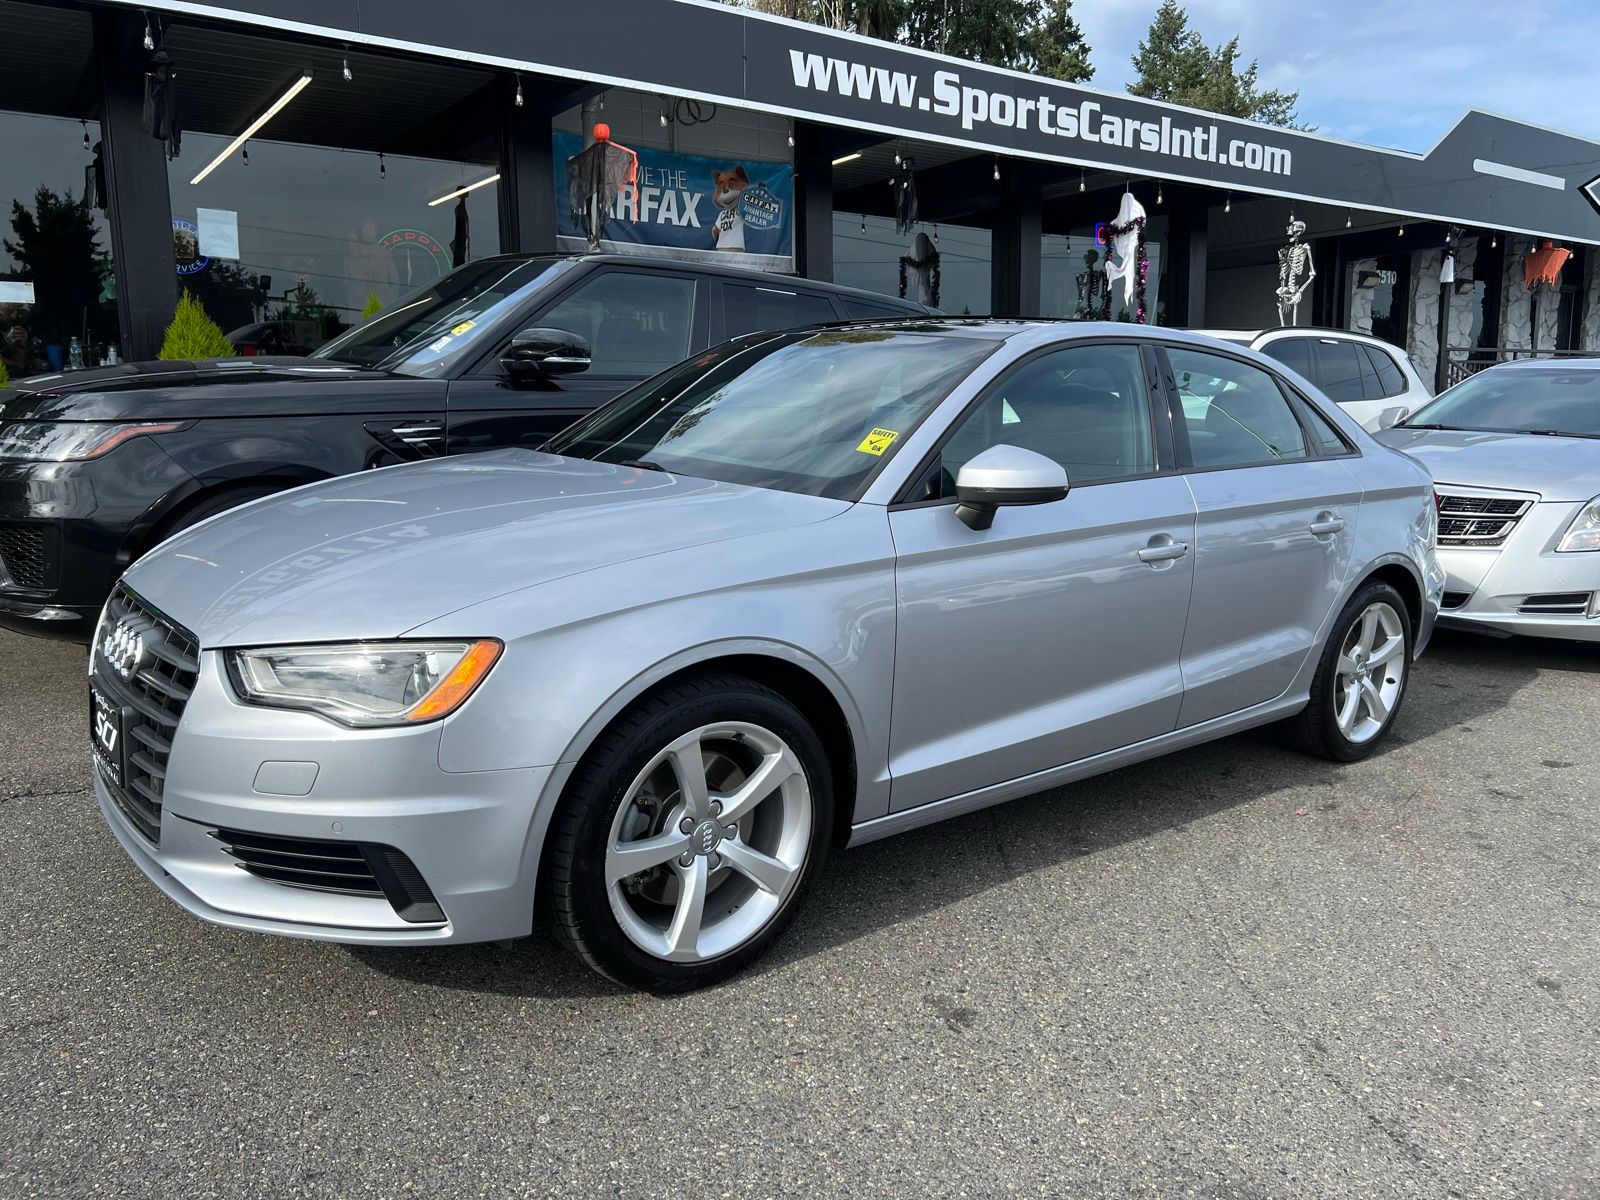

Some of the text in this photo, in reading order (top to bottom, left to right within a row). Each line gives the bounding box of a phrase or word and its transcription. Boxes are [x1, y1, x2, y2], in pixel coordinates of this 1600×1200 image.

[657, 168, 687, 190] THE
[744, 194, 778, 213] CARFAX
[720, 208, 736, 221] CAR
[744, 205, 774, 220] ADVANTAGE
[720, 220, 734, 232] FOX
[744, 213, 767, 227] DEALER
[176, 260, 203, 272] RVICE
[872, 429, 896, 438] SAFETY
[95, 711, 117, 751] SCI
